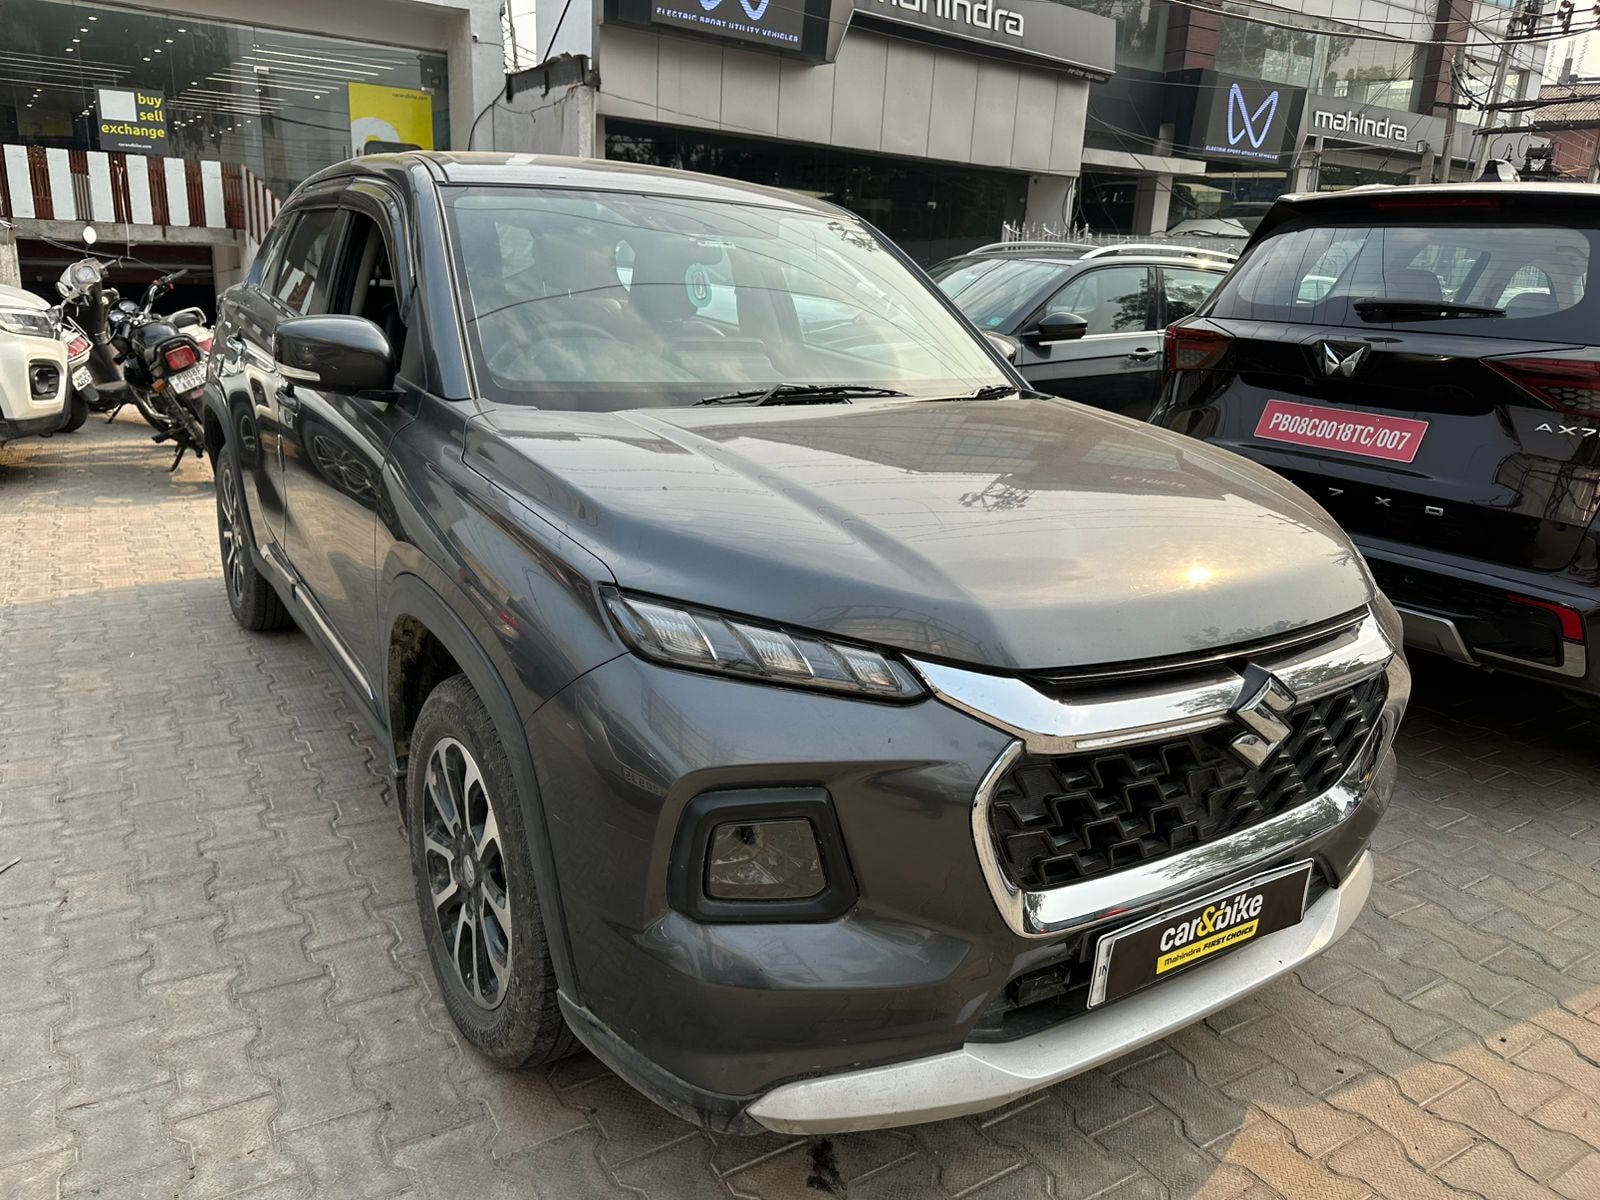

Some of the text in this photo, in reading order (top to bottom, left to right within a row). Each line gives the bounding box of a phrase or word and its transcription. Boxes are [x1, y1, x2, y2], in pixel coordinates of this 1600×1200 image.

[656, 7, 799, 42] ELECTRIC SPORT UTILITY VEHICLES
[879, 0, 1024, 37] indra
[137, 93, 162, 108] buy
[140, 110, 164, 122] sell
[1314, 110, 1408, 141] mahindra
[101, 123, 165, 139] exchange
[1269, 412, 1412, 451] PB08C0018TC/007
[1534, 423, 1600, 437] AX7
[1160, 893, 1264, 952] car&bike
[1202, 936, 1227, 951] FIRST
[1226, 925, 1255, 942] CHOICE
